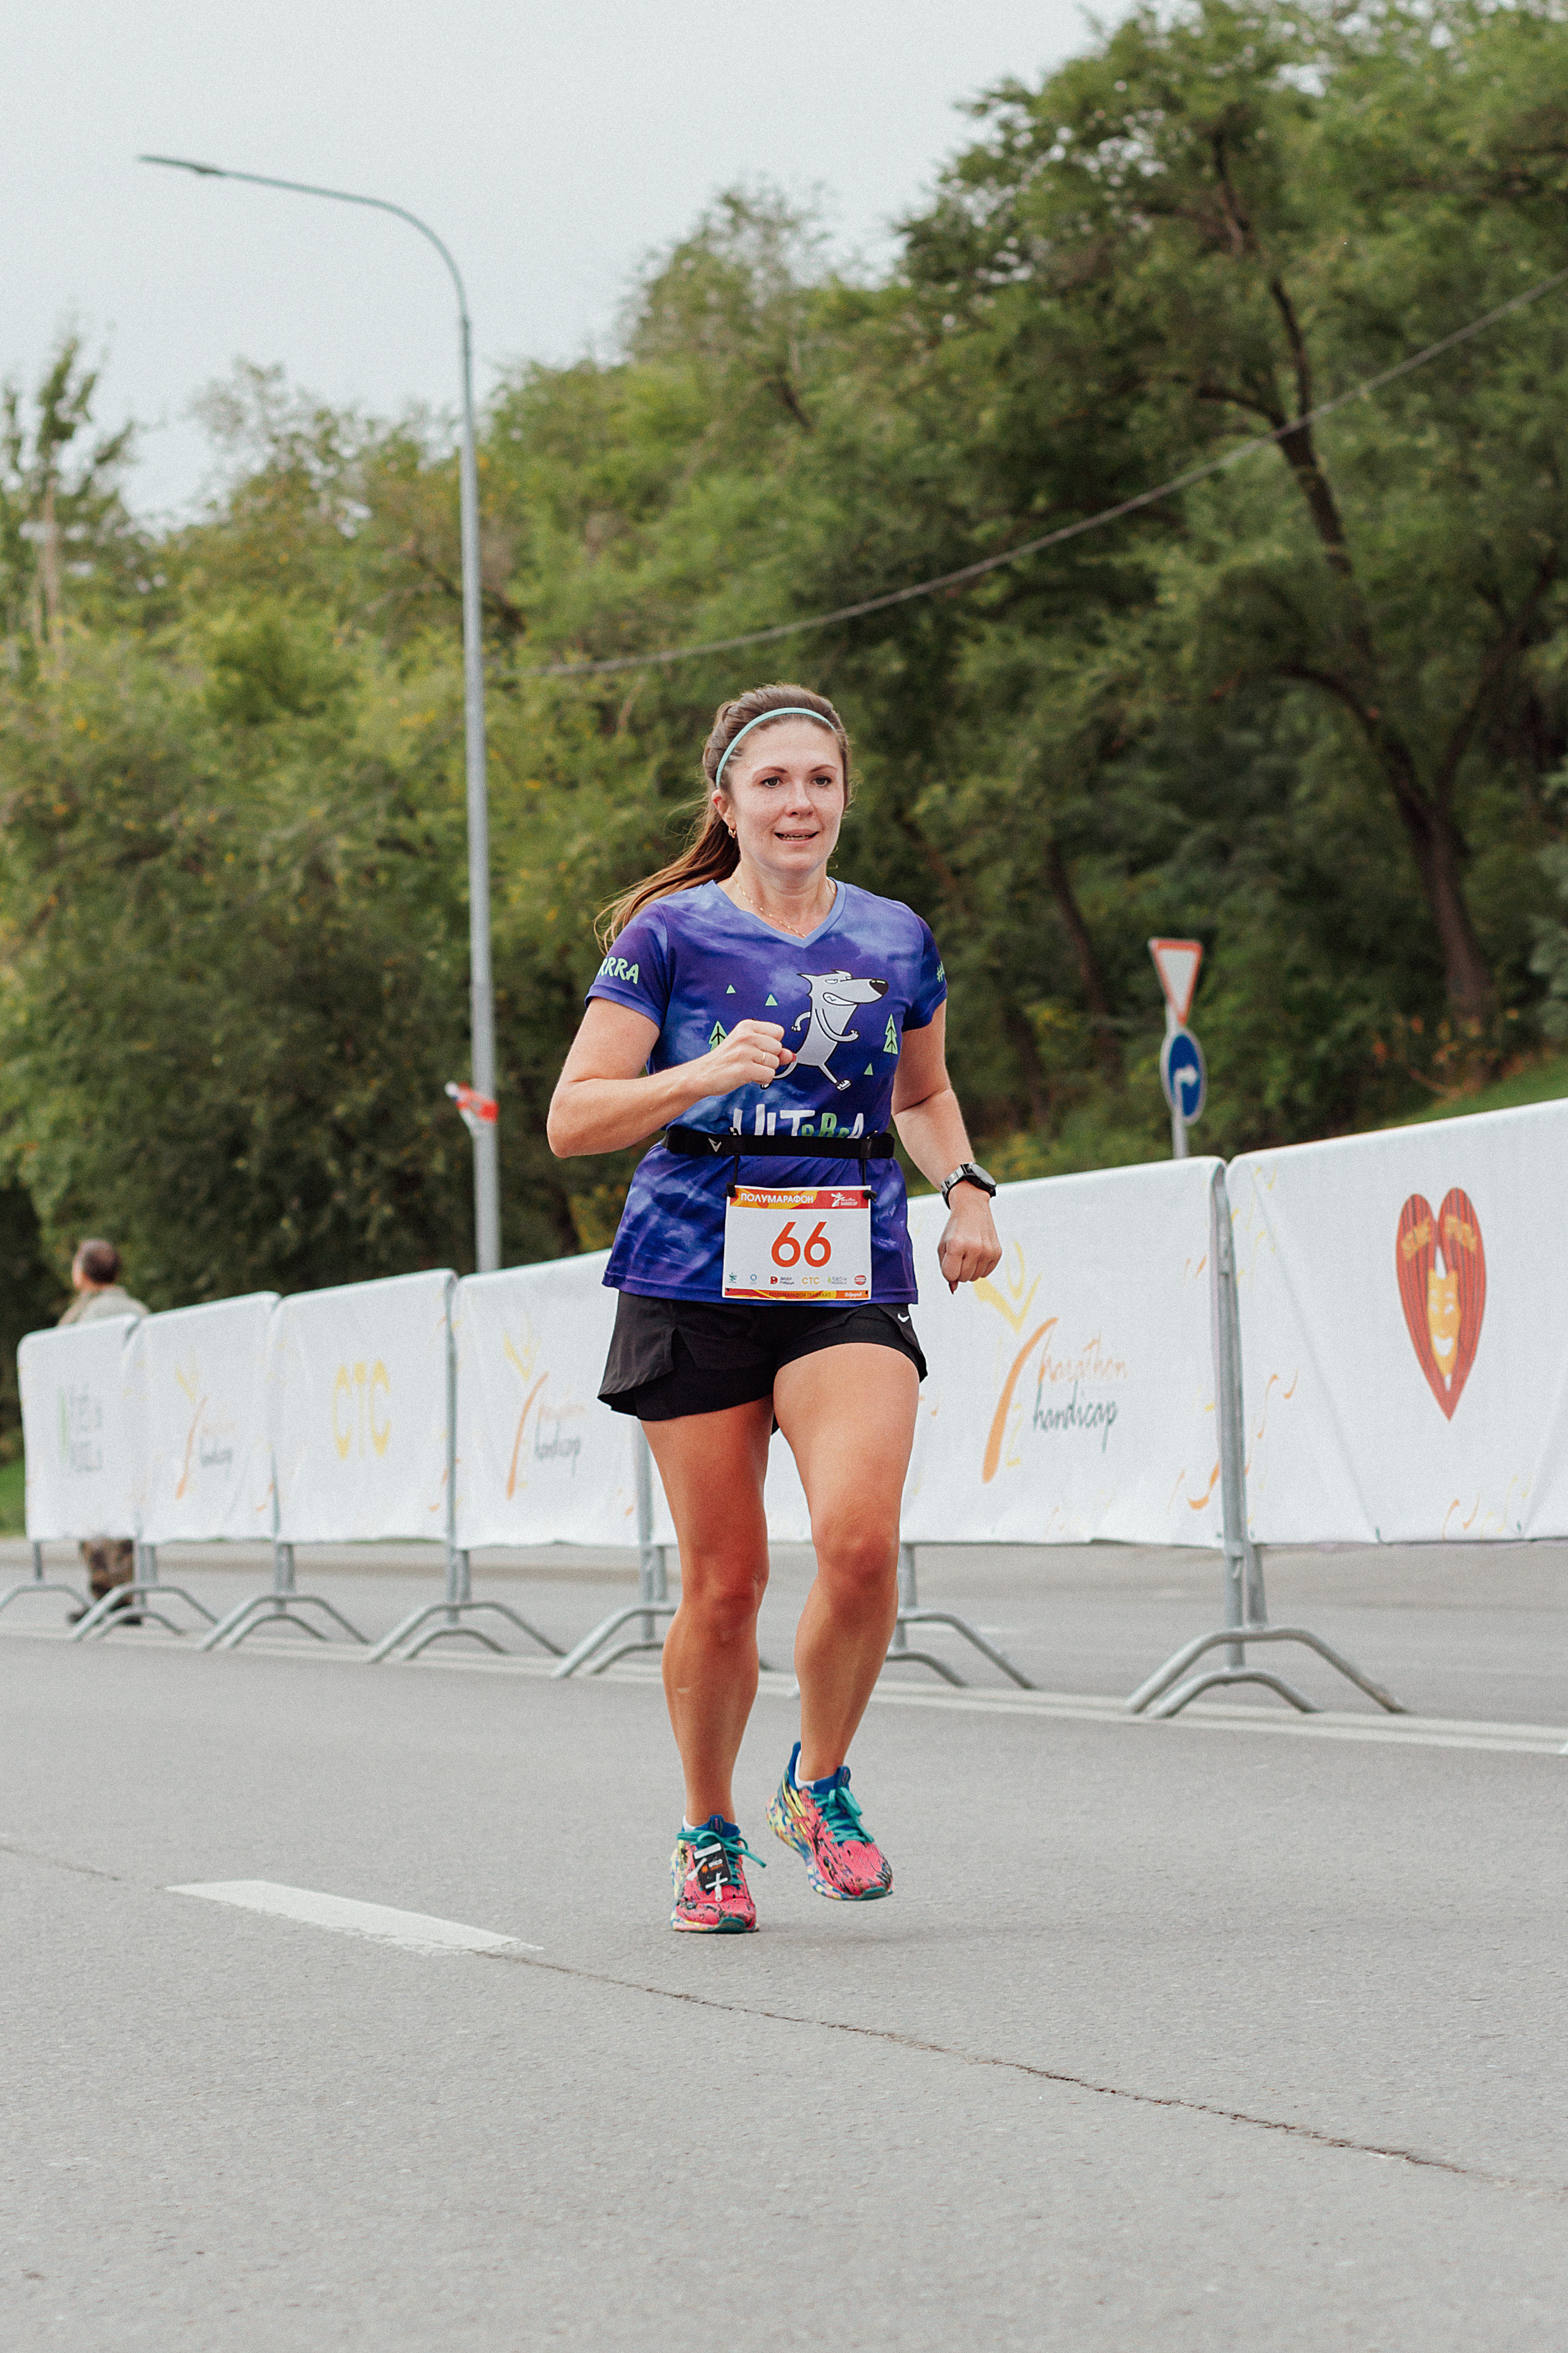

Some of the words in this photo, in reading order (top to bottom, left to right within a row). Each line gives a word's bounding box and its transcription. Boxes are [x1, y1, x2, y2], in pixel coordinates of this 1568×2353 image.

[741, 1193, 813, 1203] ПОЛУМАРАФОН
[771, 1221, 831, 1268] 66
[1032, 1380, 1119, 1454] handicap
